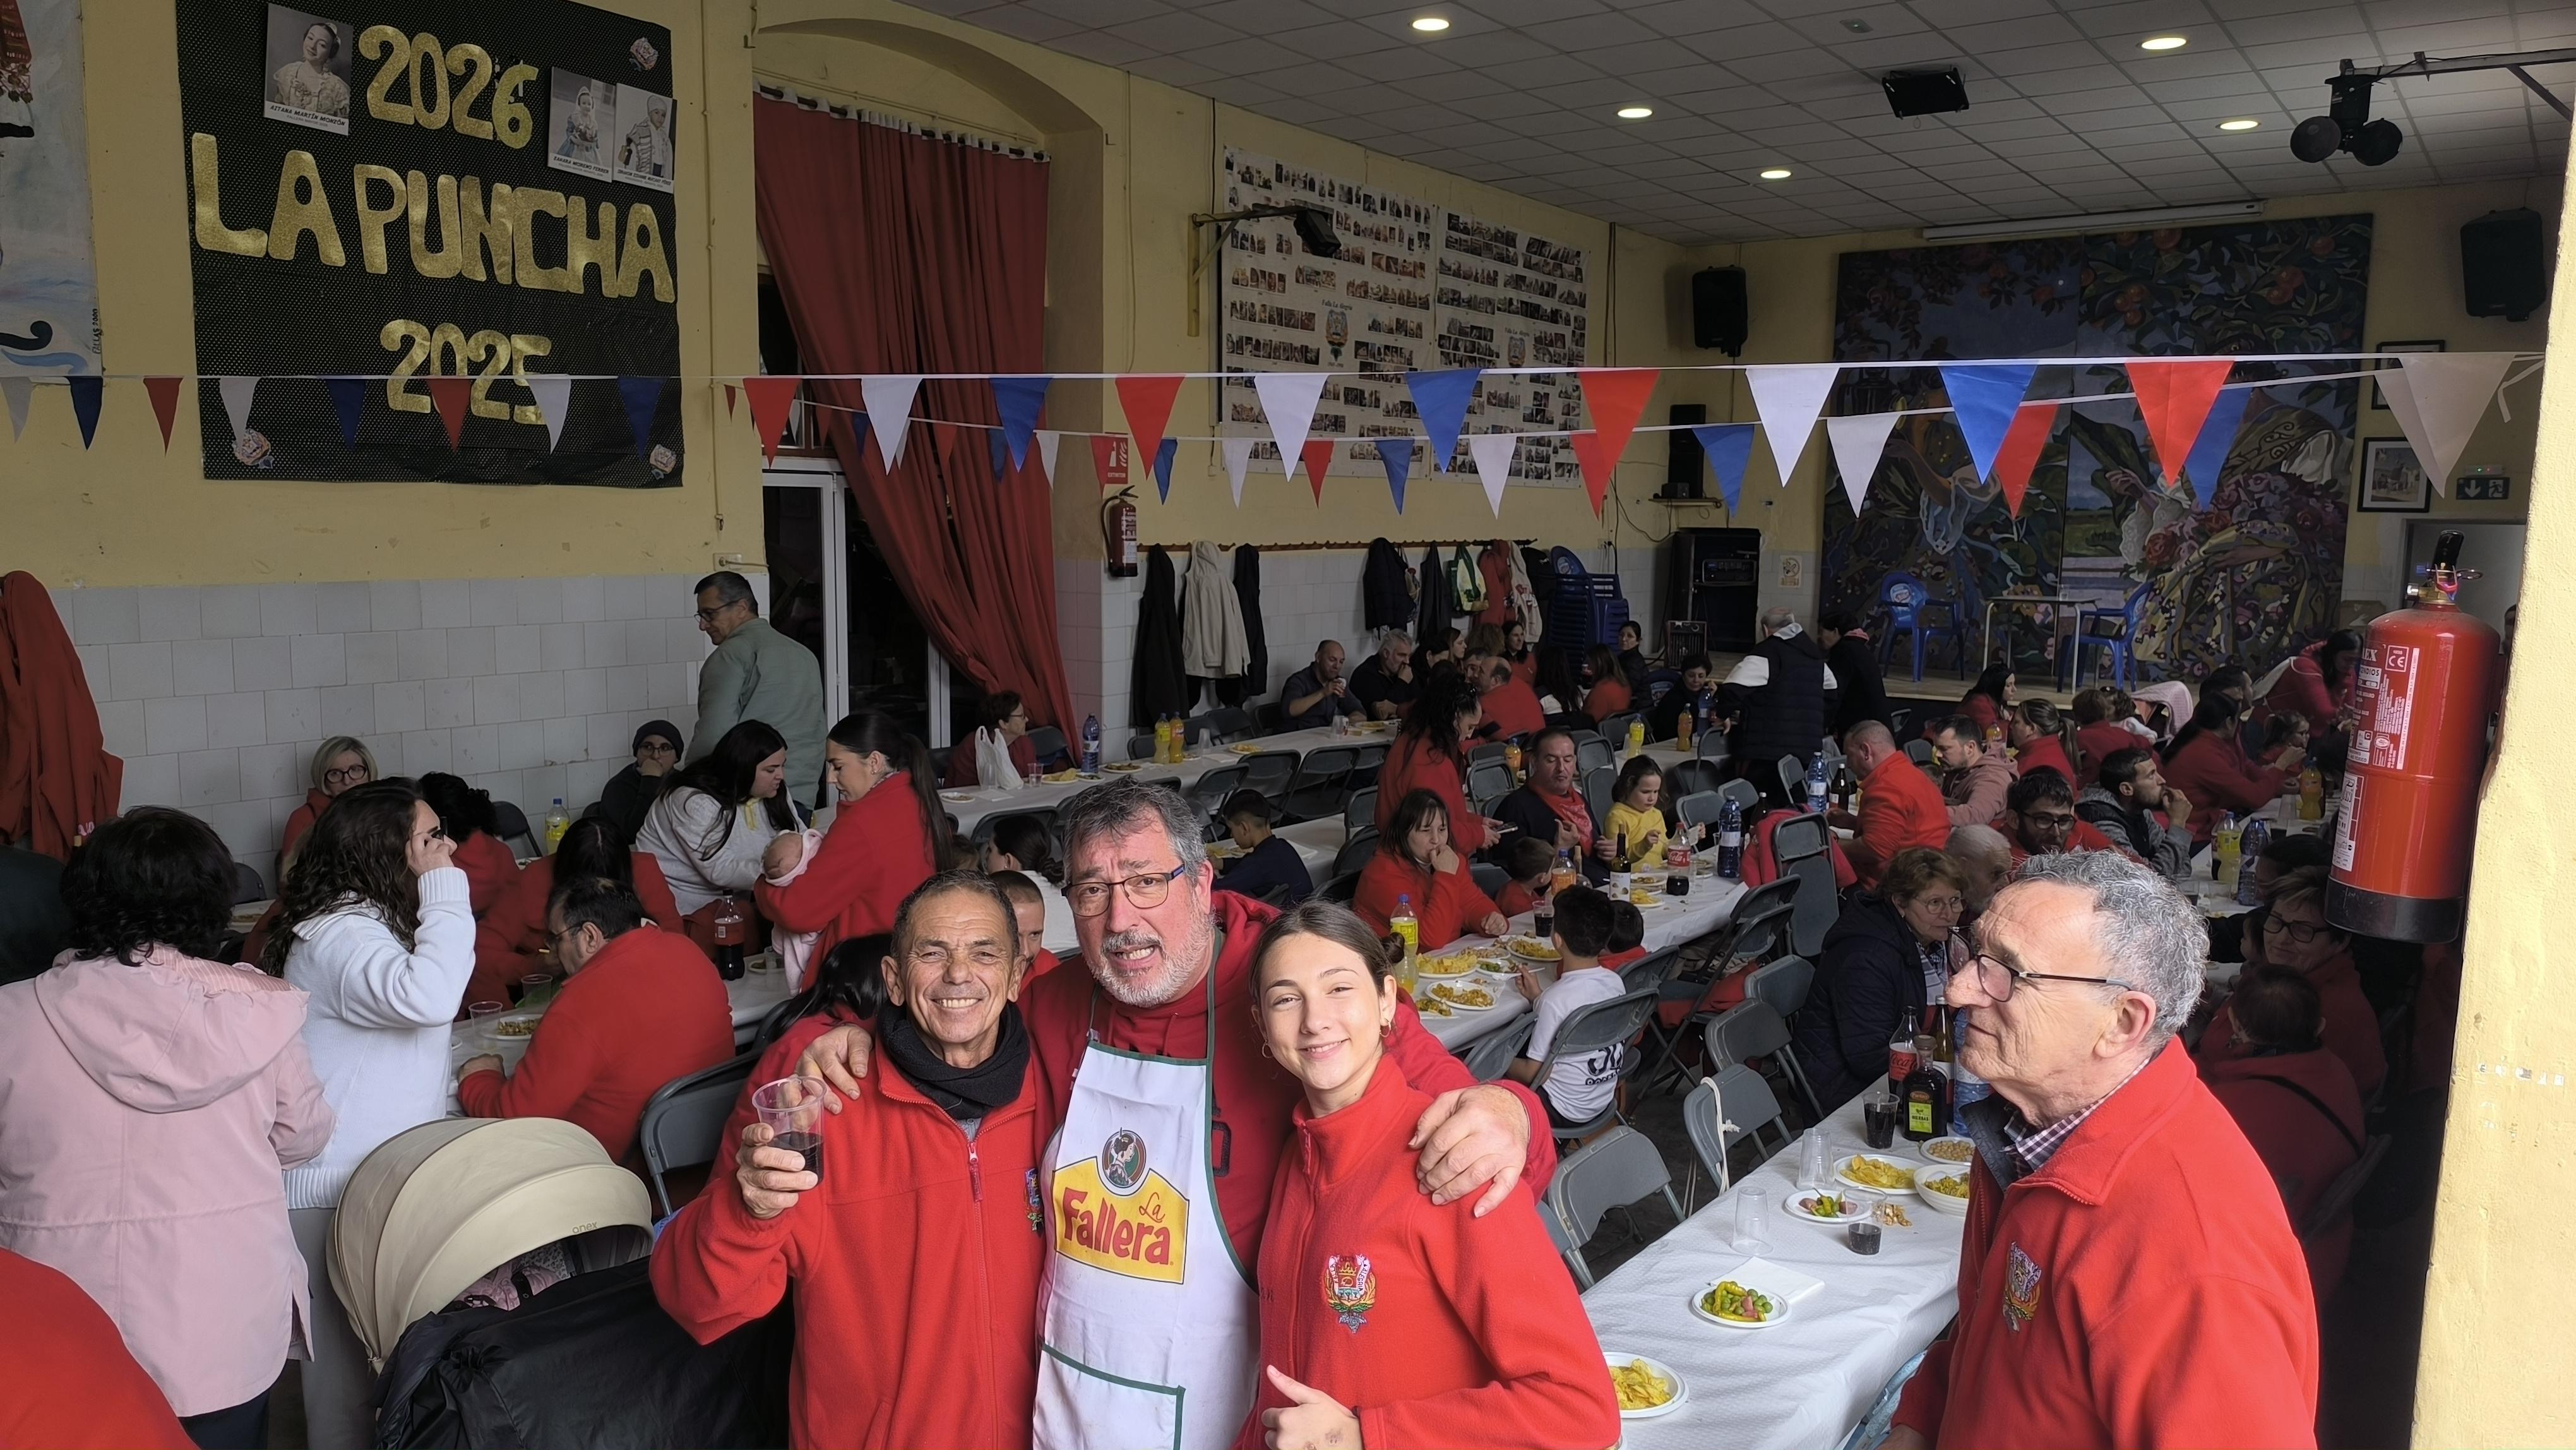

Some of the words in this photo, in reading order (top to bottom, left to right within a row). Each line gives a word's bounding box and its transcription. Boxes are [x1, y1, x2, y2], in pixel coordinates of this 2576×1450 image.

[358, 25, 539, 149] 2026
[270, 105, 292, 114] AITANA
[294, 111, 319, 120] MARTÍN
[319, 116, 346, 126] MONZÓN
[191, 133, 345, 267] LA
[354, 164, 675, 303] PUNCHA
[572, 1221, 598, 1234] anex
[1062, 1187, 1171, 1266] Fallera
[1138, 1192, 1166, 1223] La
